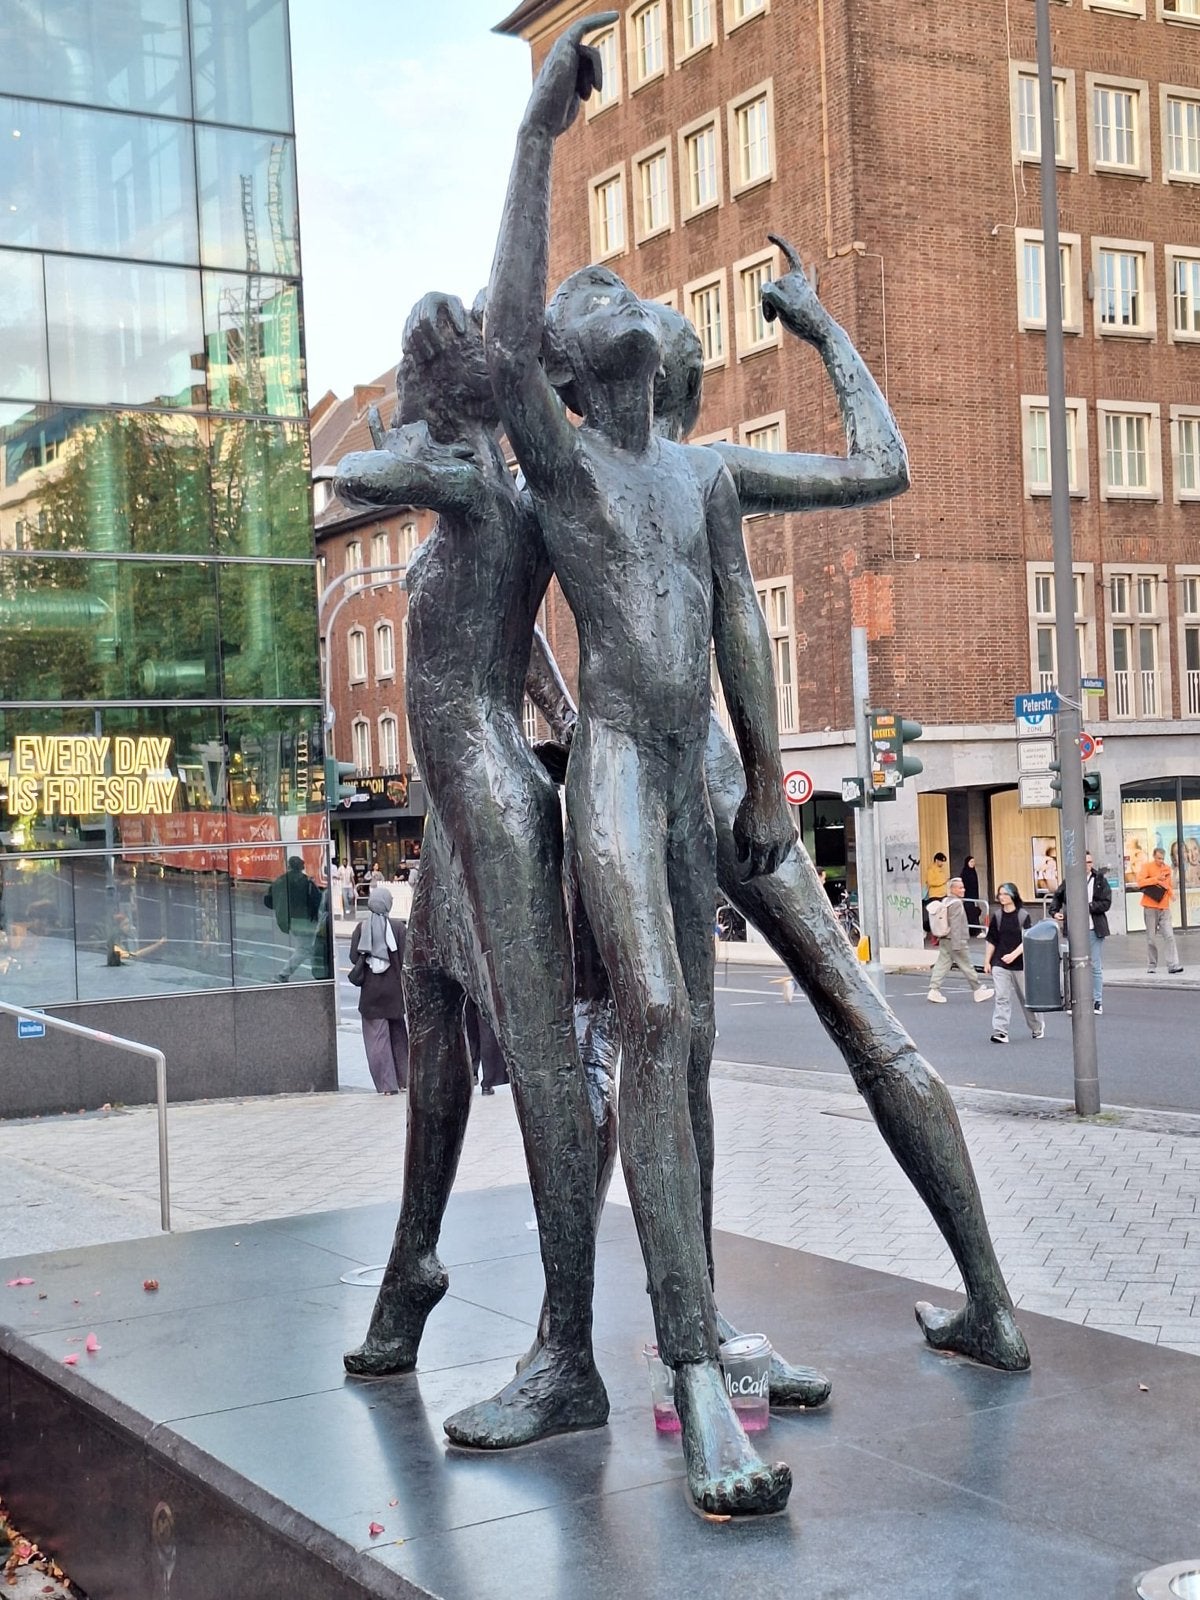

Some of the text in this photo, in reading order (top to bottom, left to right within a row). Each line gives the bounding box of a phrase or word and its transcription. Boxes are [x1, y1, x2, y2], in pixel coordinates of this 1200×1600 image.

[1023, 698, 1053, 712] Peterstr.
[15, 735, 171, 775] EVERY DAY
[8, 776, 178, 815] IS FRIESDAY
[788, 779, 806, 794] 30
